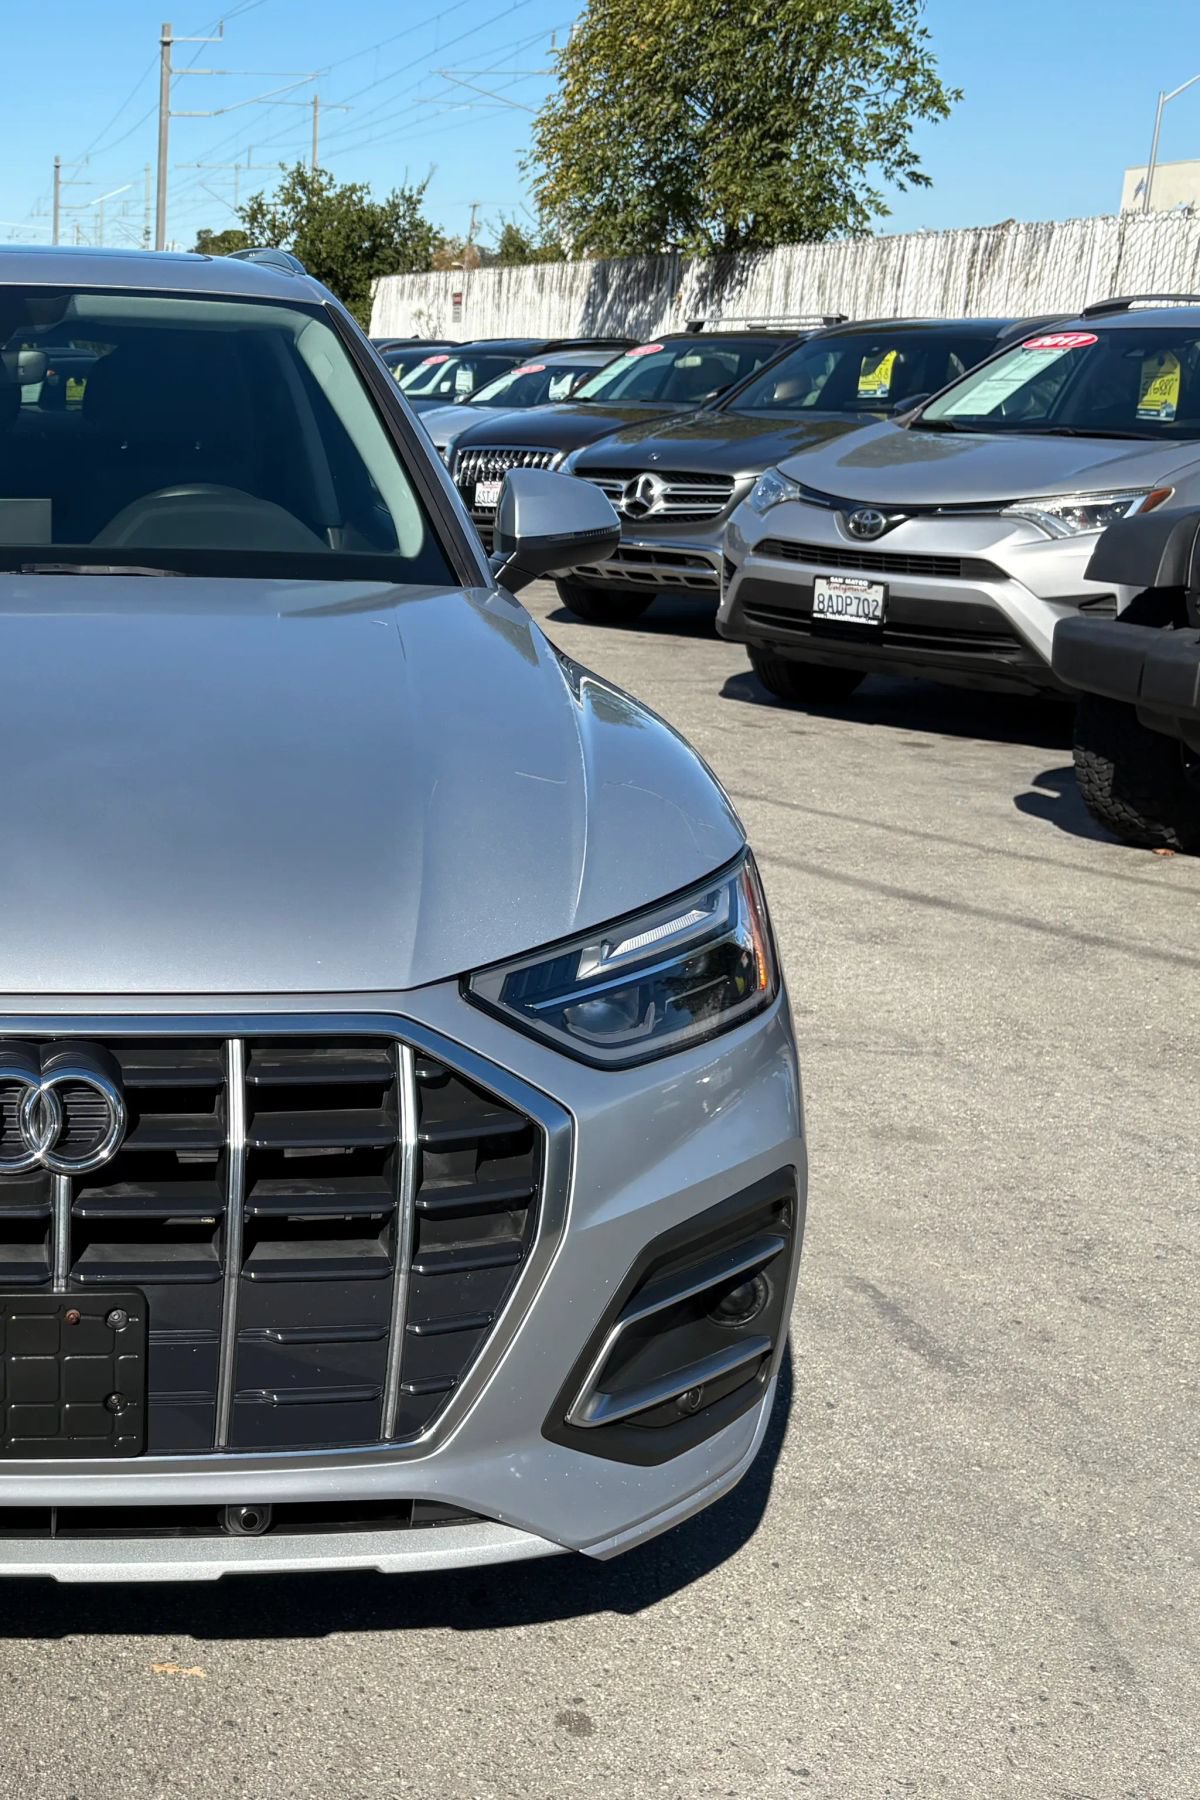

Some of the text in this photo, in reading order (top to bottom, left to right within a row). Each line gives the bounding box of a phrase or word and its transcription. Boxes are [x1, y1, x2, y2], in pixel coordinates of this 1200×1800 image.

[1031, 335, 1093, 347] 2017
[845, 578, 869, 586] MATEO
[817, 592, 880, 619] 8ADP702
